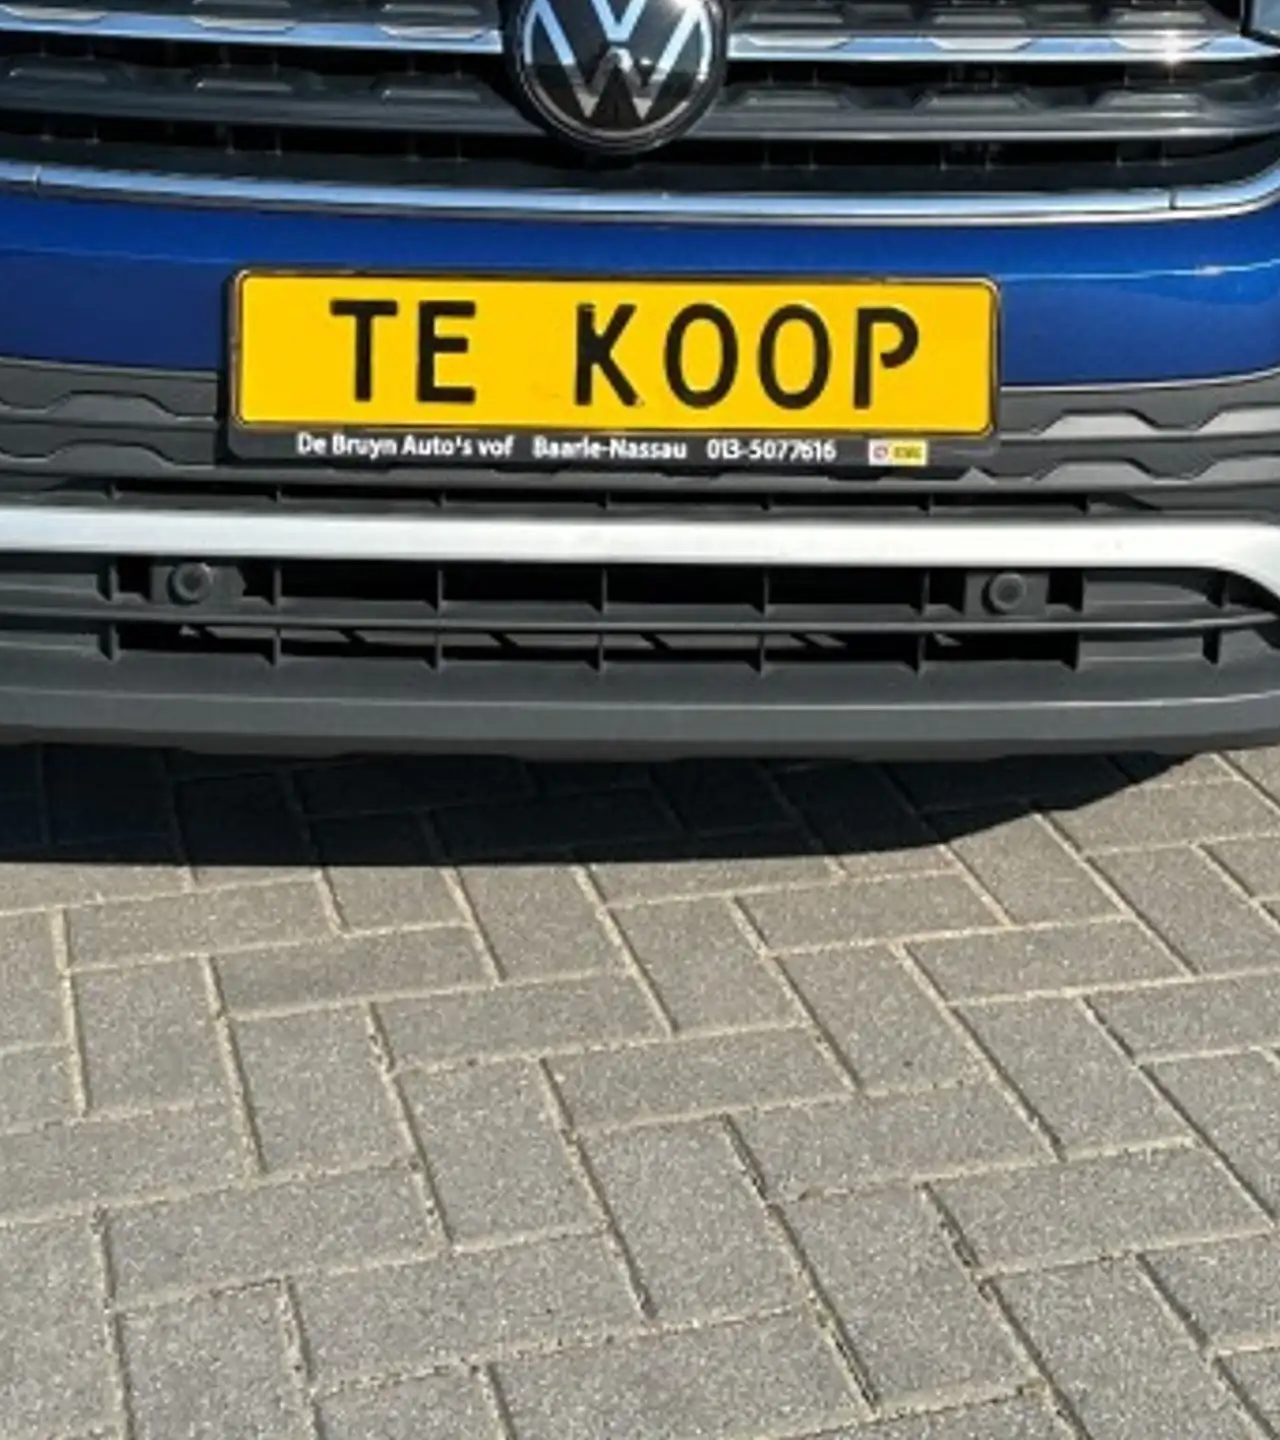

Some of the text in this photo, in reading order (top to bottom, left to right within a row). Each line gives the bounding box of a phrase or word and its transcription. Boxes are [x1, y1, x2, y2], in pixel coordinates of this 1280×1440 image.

[329, 299, 920, 410] TE KOOP
[296, 431, 838, 462] De Bruyn Auto's vof Baarle-Nassau 013-5077616
